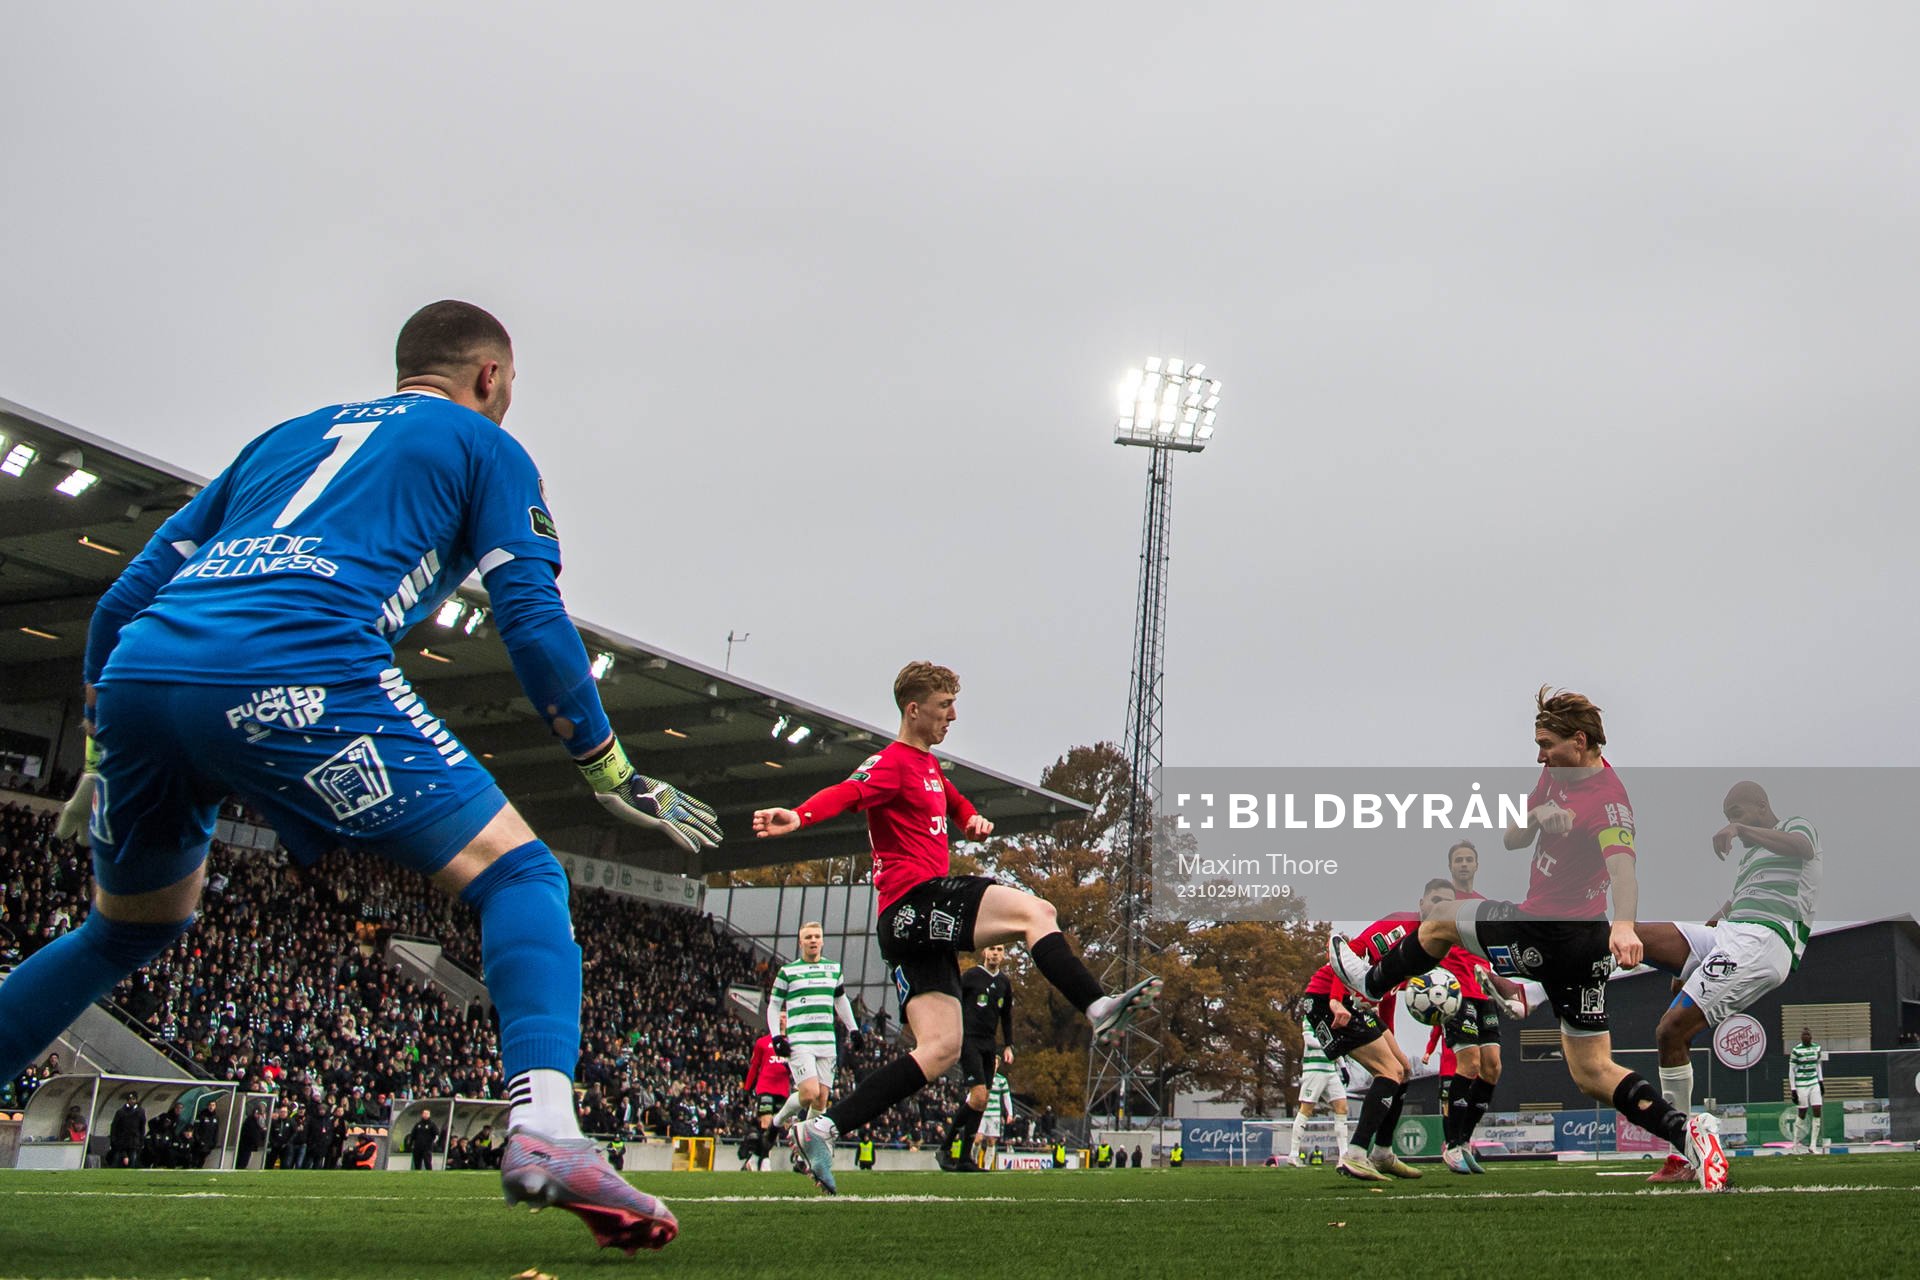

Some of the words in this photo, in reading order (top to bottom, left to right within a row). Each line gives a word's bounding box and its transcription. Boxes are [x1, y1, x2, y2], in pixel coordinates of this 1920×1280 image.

[332, 403, 417, 420] FISK
[272, 421, 383, 529] 1
[207, 534, 323, 559] NORDIC
[171, 554, 339, 578] WELLNESS
[281, 702, 325, 729] UP
[1618, 830, 1631, 845] C
[1189, 1127, 1263, 1148] Carpenter
